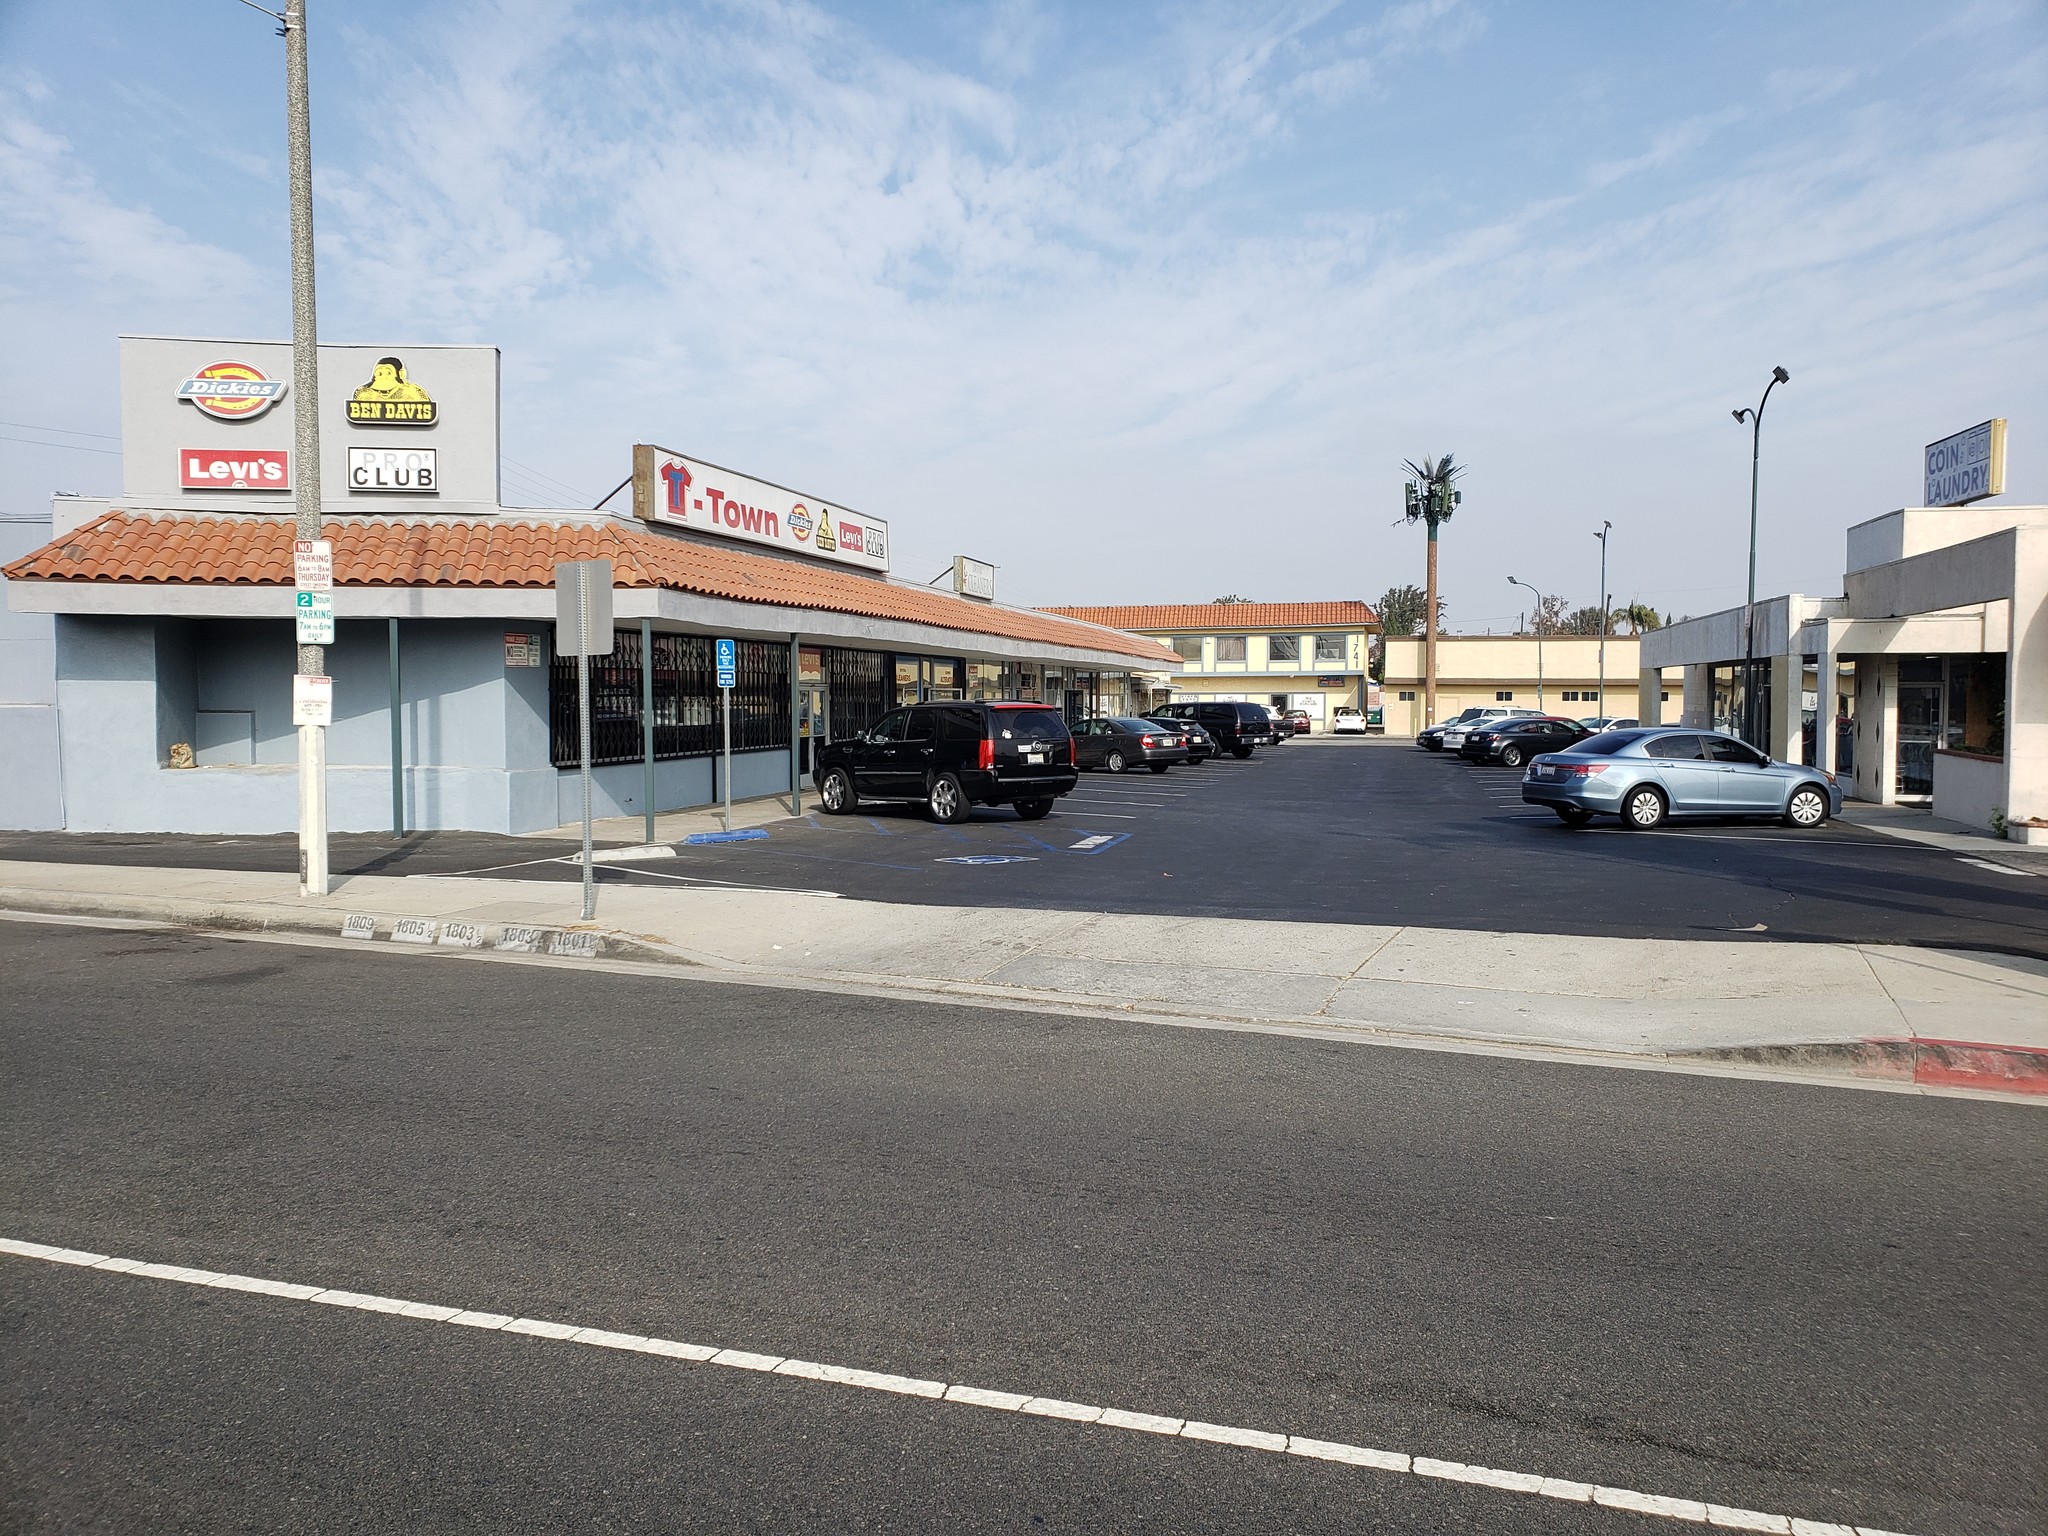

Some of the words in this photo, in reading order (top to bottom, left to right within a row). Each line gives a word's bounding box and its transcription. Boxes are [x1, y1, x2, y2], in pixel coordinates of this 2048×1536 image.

[187, 381, 273, 395] Dickies
[350, 402, 382, 418] BEN
[385, 403, 432, 420] DAVIS
[1928, 443, 1960, 476] COIN
[188, 457, 283, 480] Levi's
[353, 466, 433, 486] CLUB
[1927, 463, 1988, 504] LAUNDRY
[841, 528, 862, 547] Levi's
[297, 542, 311, 552] NO
[297, 554, 329, 563] PARKING
[317, 564, 330, 573] 8AM
[298, 572, 330, 582] THURSDAY
[300, 593, 309, 606] 2
[313, 596, 331, 604] HOUR
[298, 609, 332, 620] PARKING
[299, 621, 311, 630] 7AM
[318, 622, 332, 631] 6PM
[346, 915, 375, 931] 1809
[397, 919, 424, 936] 1805
[445, 922, 475, 941] 1803
